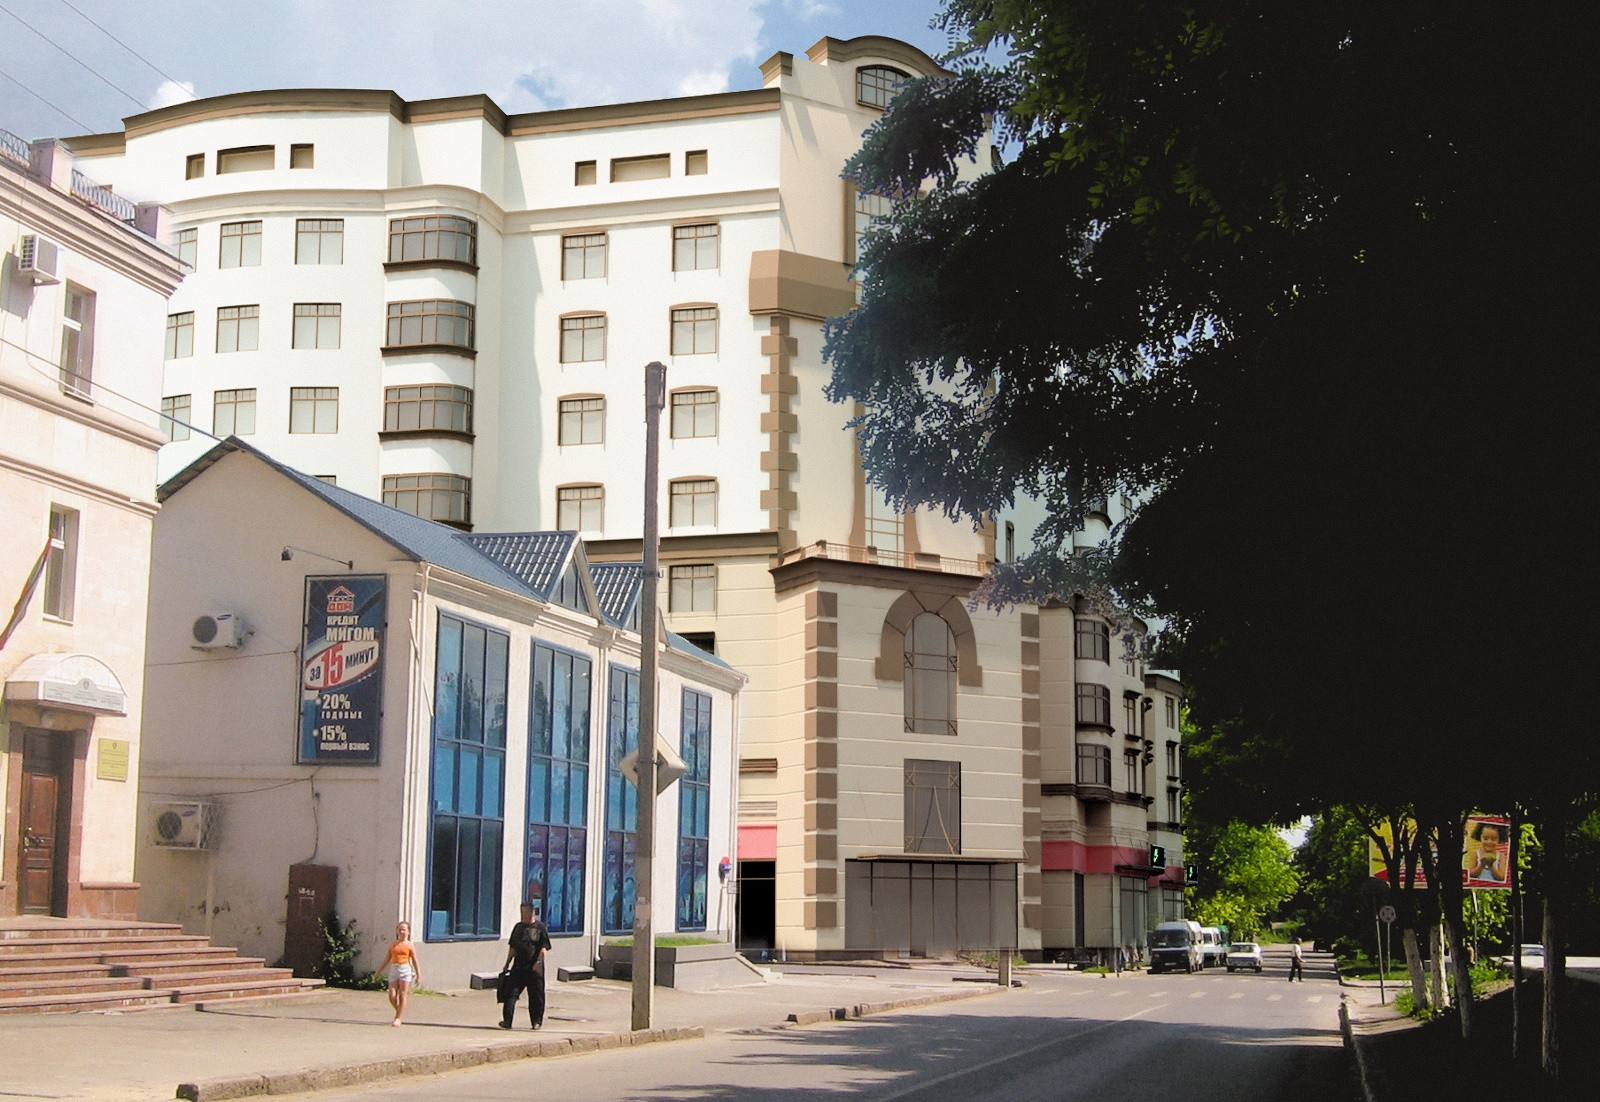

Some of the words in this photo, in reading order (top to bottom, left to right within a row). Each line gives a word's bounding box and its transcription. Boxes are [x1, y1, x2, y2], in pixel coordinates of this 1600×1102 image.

[326, 615, 359, 626] КРЕДИТ
[326, 627, 375, 641] МИГОМ
[321, 643, 343, 688] 15
[322, 693, 351, 710] 20%
[320, 725, 347, 741] 15%
